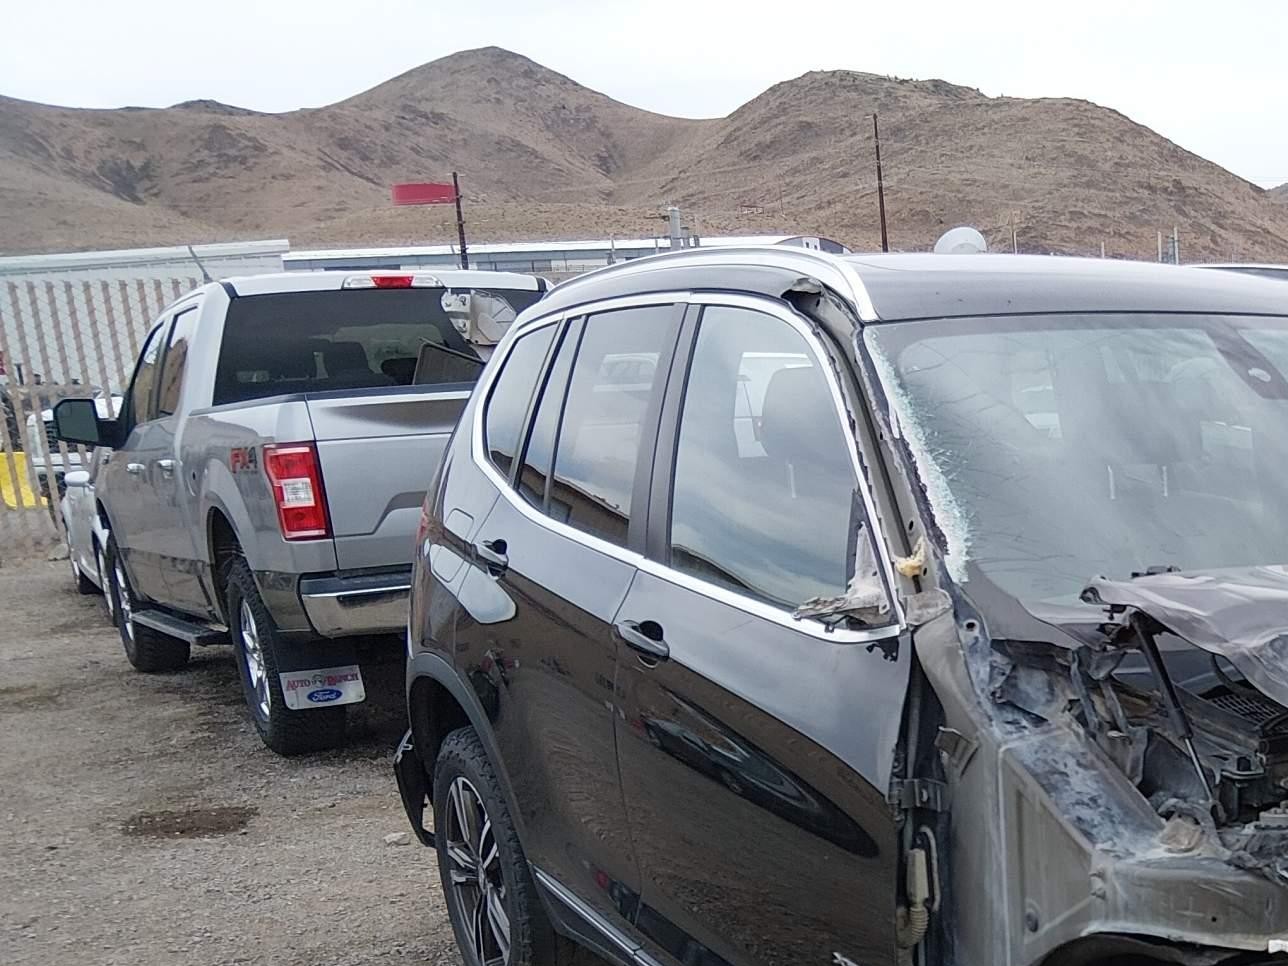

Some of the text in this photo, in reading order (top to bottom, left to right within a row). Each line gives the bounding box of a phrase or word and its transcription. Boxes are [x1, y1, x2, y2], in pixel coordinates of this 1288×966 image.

[231, 446, 257, 472] FX4
[287, 679, 311, 690] AUTO
[311, 690, 337, 701] Ford
